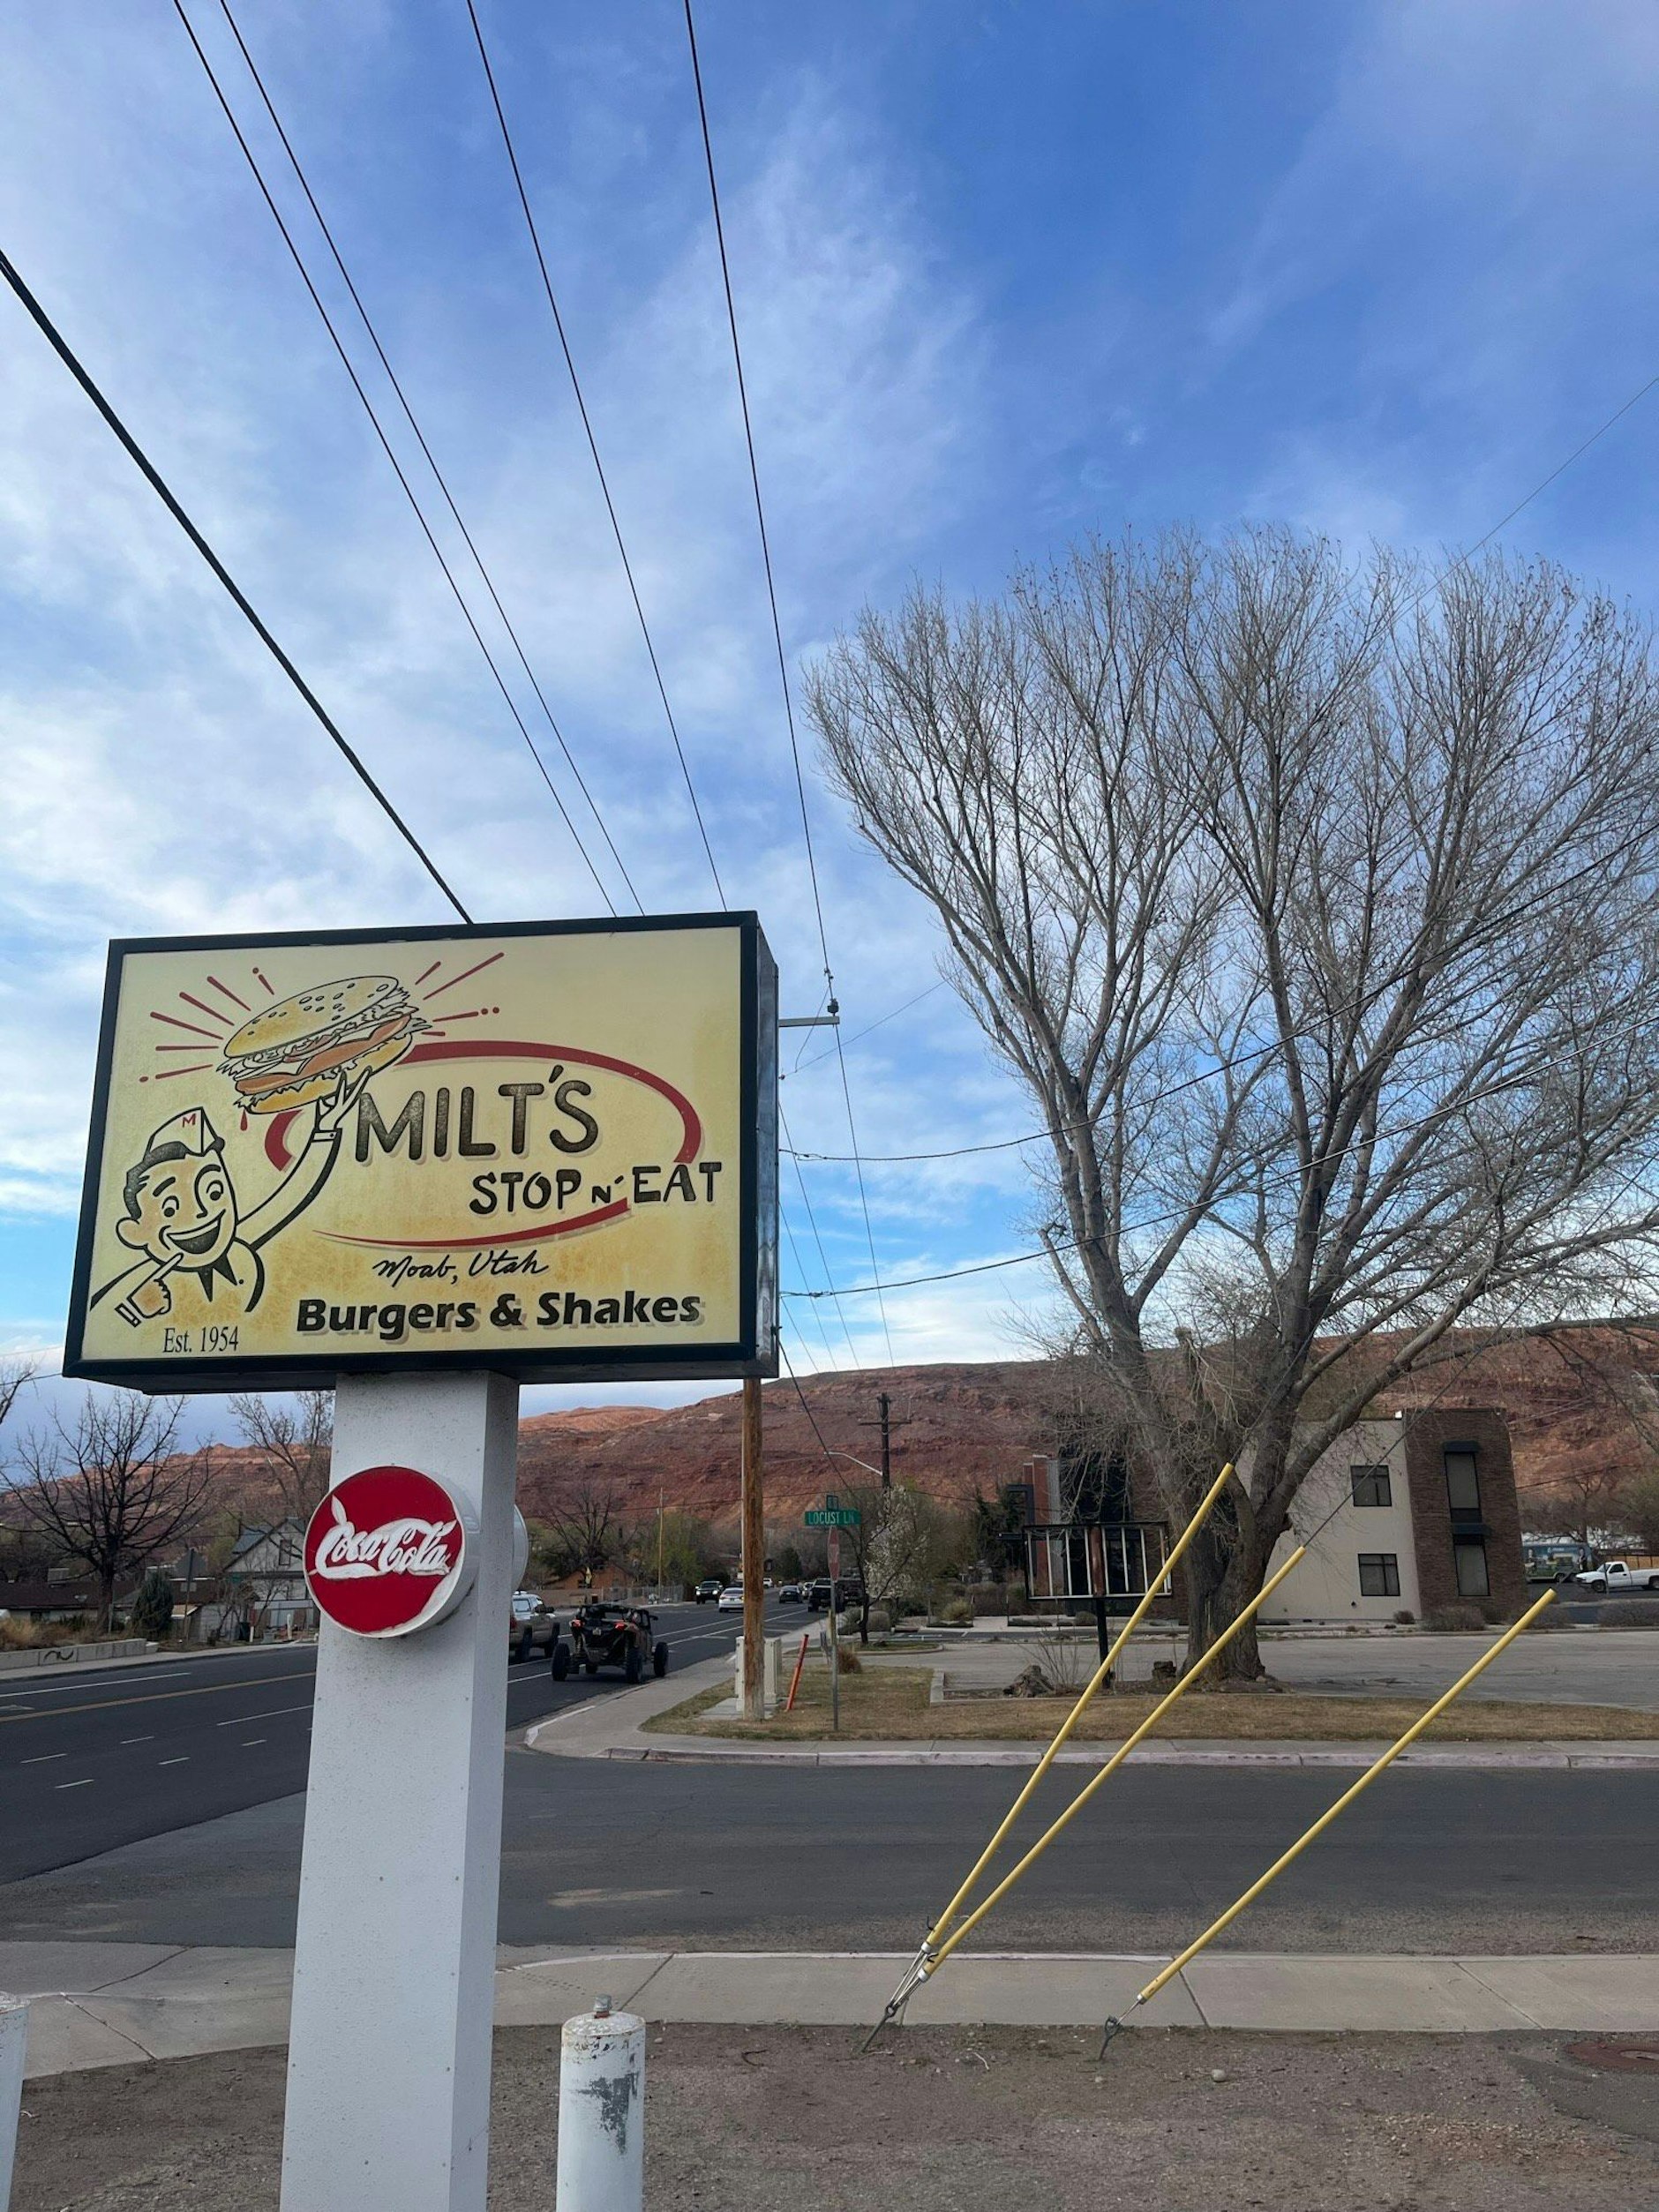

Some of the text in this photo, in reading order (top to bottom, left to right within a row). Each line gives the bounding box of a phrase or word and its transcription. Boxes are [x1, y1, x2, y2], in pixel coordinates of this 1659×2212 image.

[182, 1113, 196, 1128] M
[356, 1064, 599, 1163] MILT'S
[469, 1168, 582, 1215] STOP
[632, 1161, 723, 1203] EAT
[372, 1249, 550, 1288] Moab, Utah
[297, 1290, 702, 1340] Burgers & Shakes
[162, 1325, 239, 1353] Est. 1954
[807, 1511, 841, 1525] LOCUST
